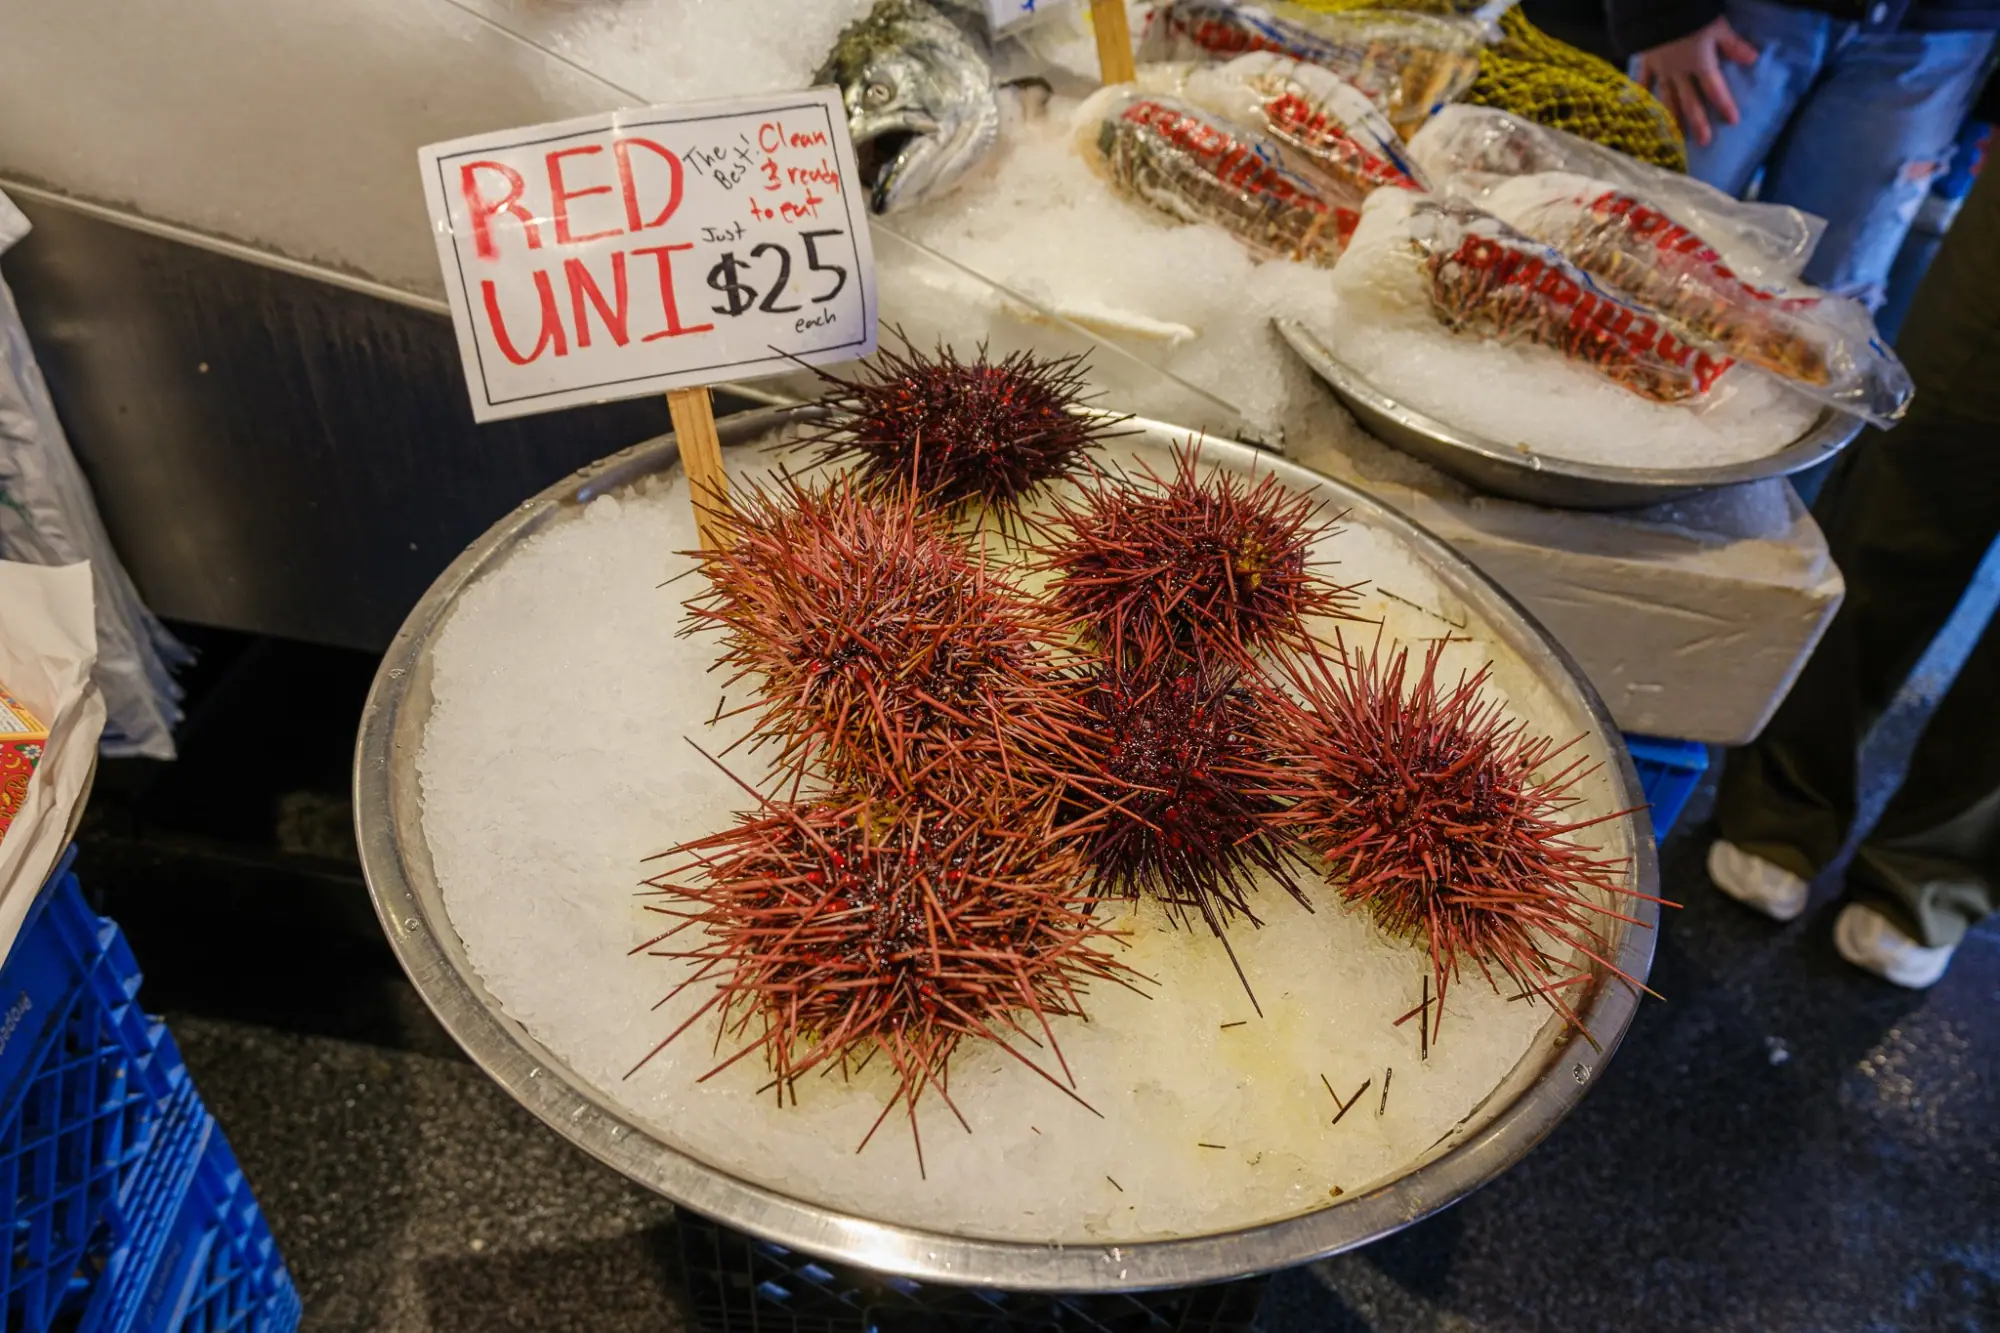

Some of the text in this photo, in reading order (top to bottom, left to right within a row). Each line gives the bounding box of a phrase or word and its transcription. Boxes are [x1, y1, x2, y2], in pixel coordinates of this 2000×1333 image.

[758, 121, 827, 153] Clean
[682, 145, 727, 175] The
[713, 133, 760, 190] Best!
[787, 158, 840, 194] ready
[460, 137, 684, 260] RED
[749, 188, 823, 224] to eat
[701, 221, 747, 242] Just
[707, 228, 847, 317] $25
[481, 242, 715, 365] UNI
[795, 308, 836, 333] each
